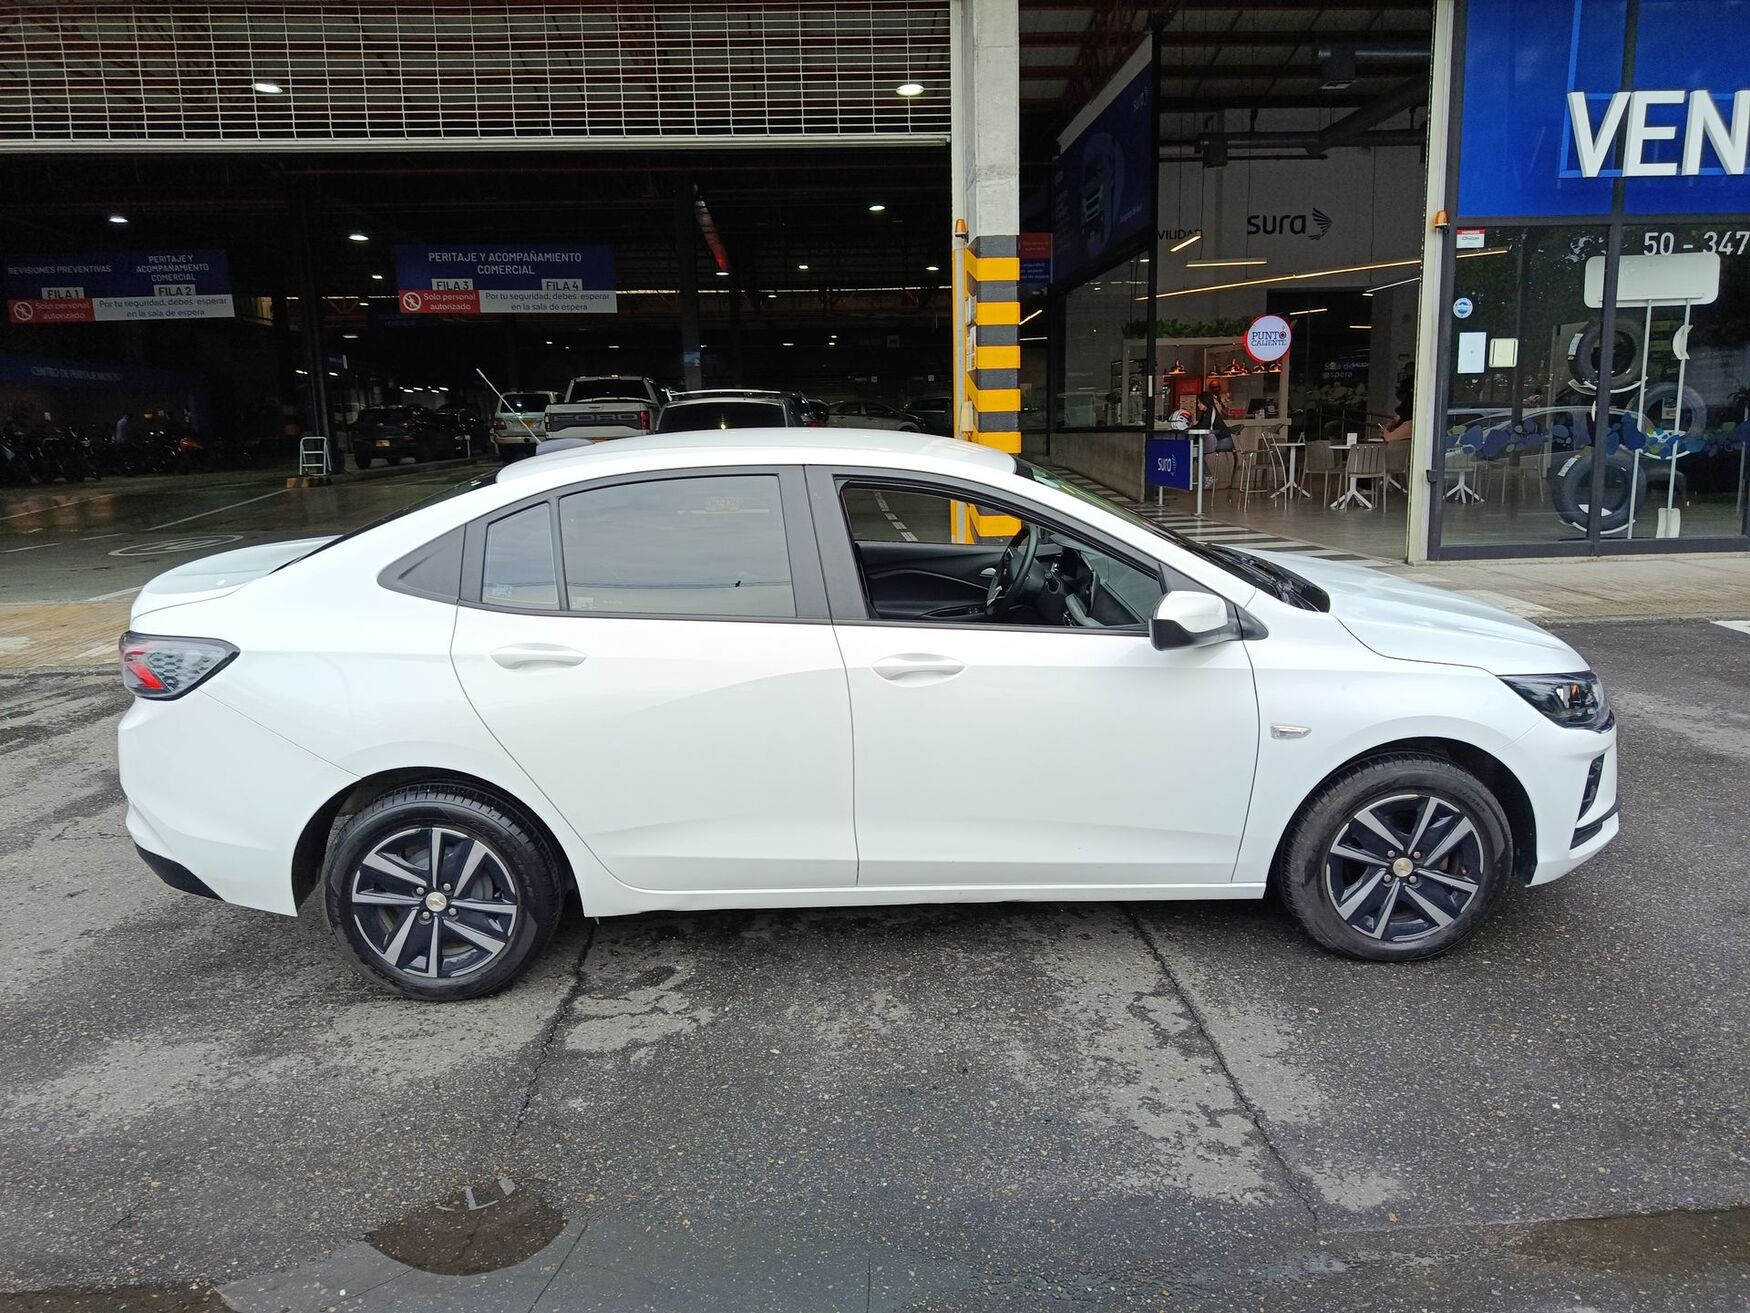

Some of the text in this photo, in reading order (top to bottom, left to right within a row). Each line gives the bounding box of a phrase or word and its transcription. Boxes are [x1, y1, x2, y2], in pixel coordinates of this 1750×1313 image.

[1567, 90, 1750, 178] VEN
[1247, 214, 1306, 235] sura
[1643, 232, 1675, 256] 50
[1702, 231, 1750, 255] 347
[149, 255, 187, 264] PERITAJE
[428, 250, 582, 262] PERITAJE Y ACOMPAÑAMIENTO
[57, 264, 112, 274] PREVENTIVAS
[477, 264, 535, 275] COMERCIAL
[151, 273, 196, 282] COMERCIAL
[436, 280, 469, 291] FILA 3
[546, 280, 579, 291] FILA 4
[47, 289, 79, 299] FILA 1
[158, 286, 193, 297] FILA 2
[423, 292, 476, 302] Solo personal
[485, 292, 498, 300] Por
[499, 292, 507, 300] tu
[580, 293, 609, 302] esperar
[99, 300, 112, 308] Por
[115, 299, 123, 307] tu
[197, 298, 227, 308] esperar
[430, 302, 472, 311] autorizado
[523, 303, 531, 311] la
[532, 303, 547, 311] sala
[549, 303, 559, 311] de
[561, 304, 588, 312] espera
[139, 309, 147, 317] la
[148, 309, 163, 317] sala
[165, 308, 176, 316] de
[178, 308, 205, 318] espera
[1252, 330, 1287, 341] PUNTO
[1251, 339, 1287, 347] CALIENTE
[553, 413, 638, 422] FORD
